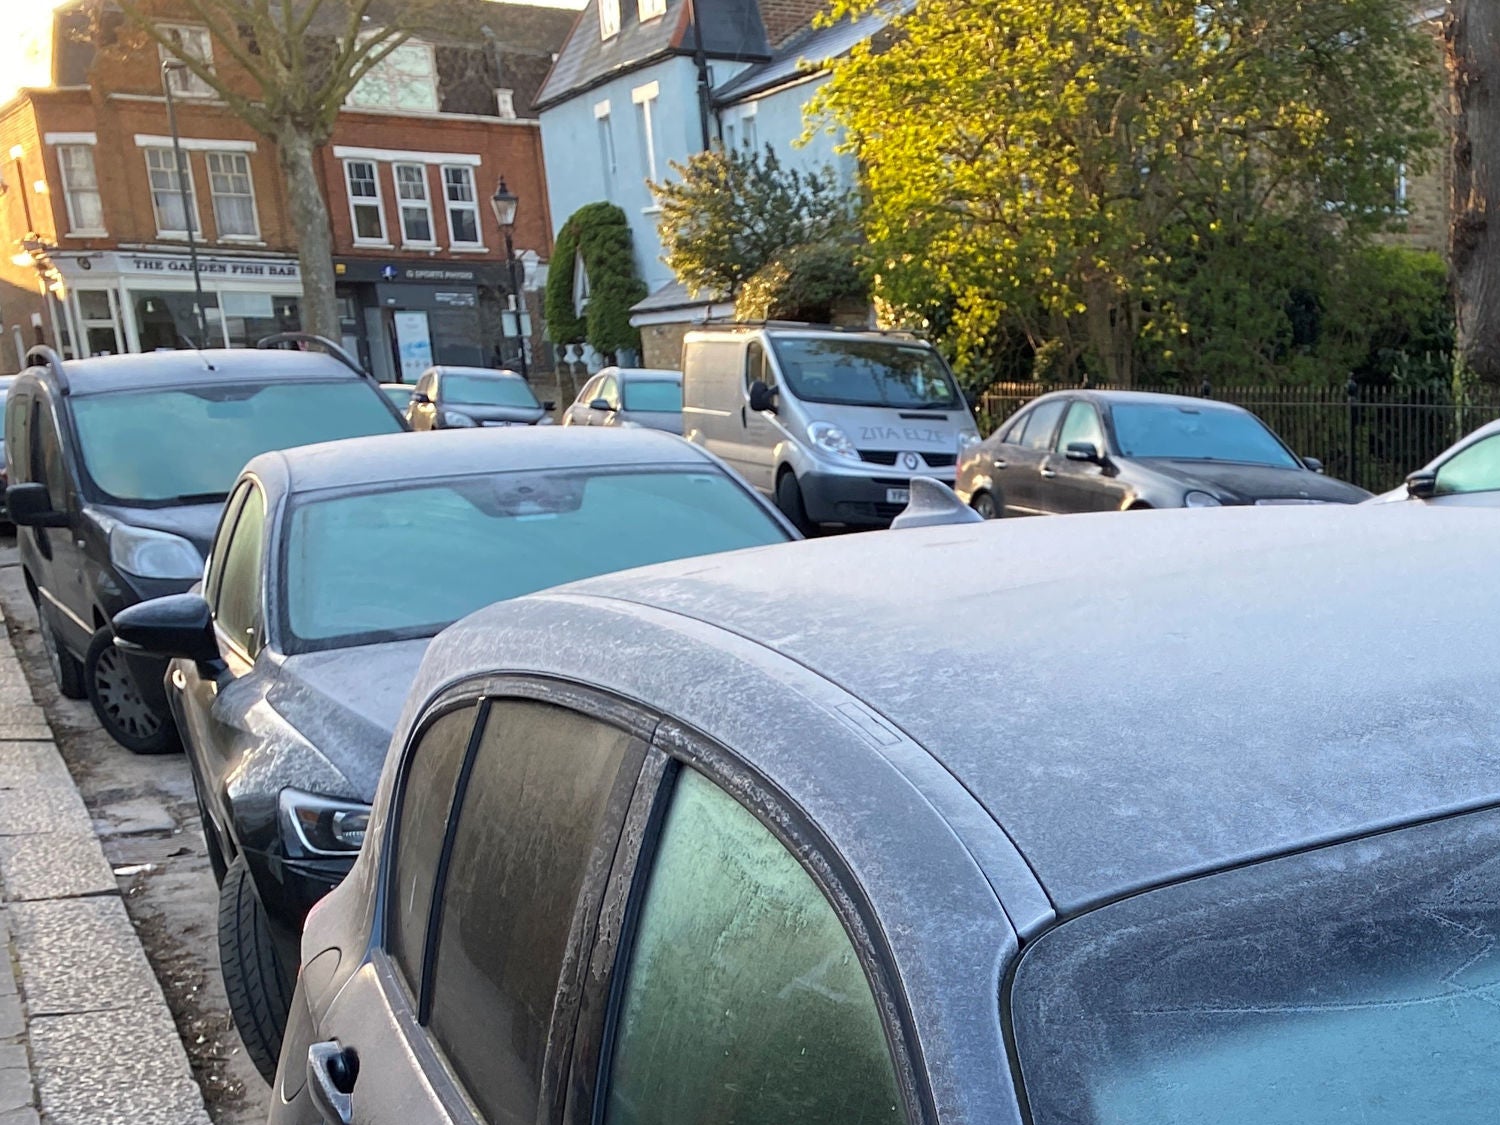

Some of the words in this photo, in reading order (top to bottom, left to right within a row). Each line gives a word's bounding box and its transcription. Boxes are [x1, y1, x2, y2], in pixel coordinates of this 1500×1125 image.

[134, 259, 164, 270] THE
[231, 264, 264, 275] FISH
[268, 265, 297, 276] BAR
[859, 426, 900, 440] ZITA
[903, 428, 947, 444] ELZE
